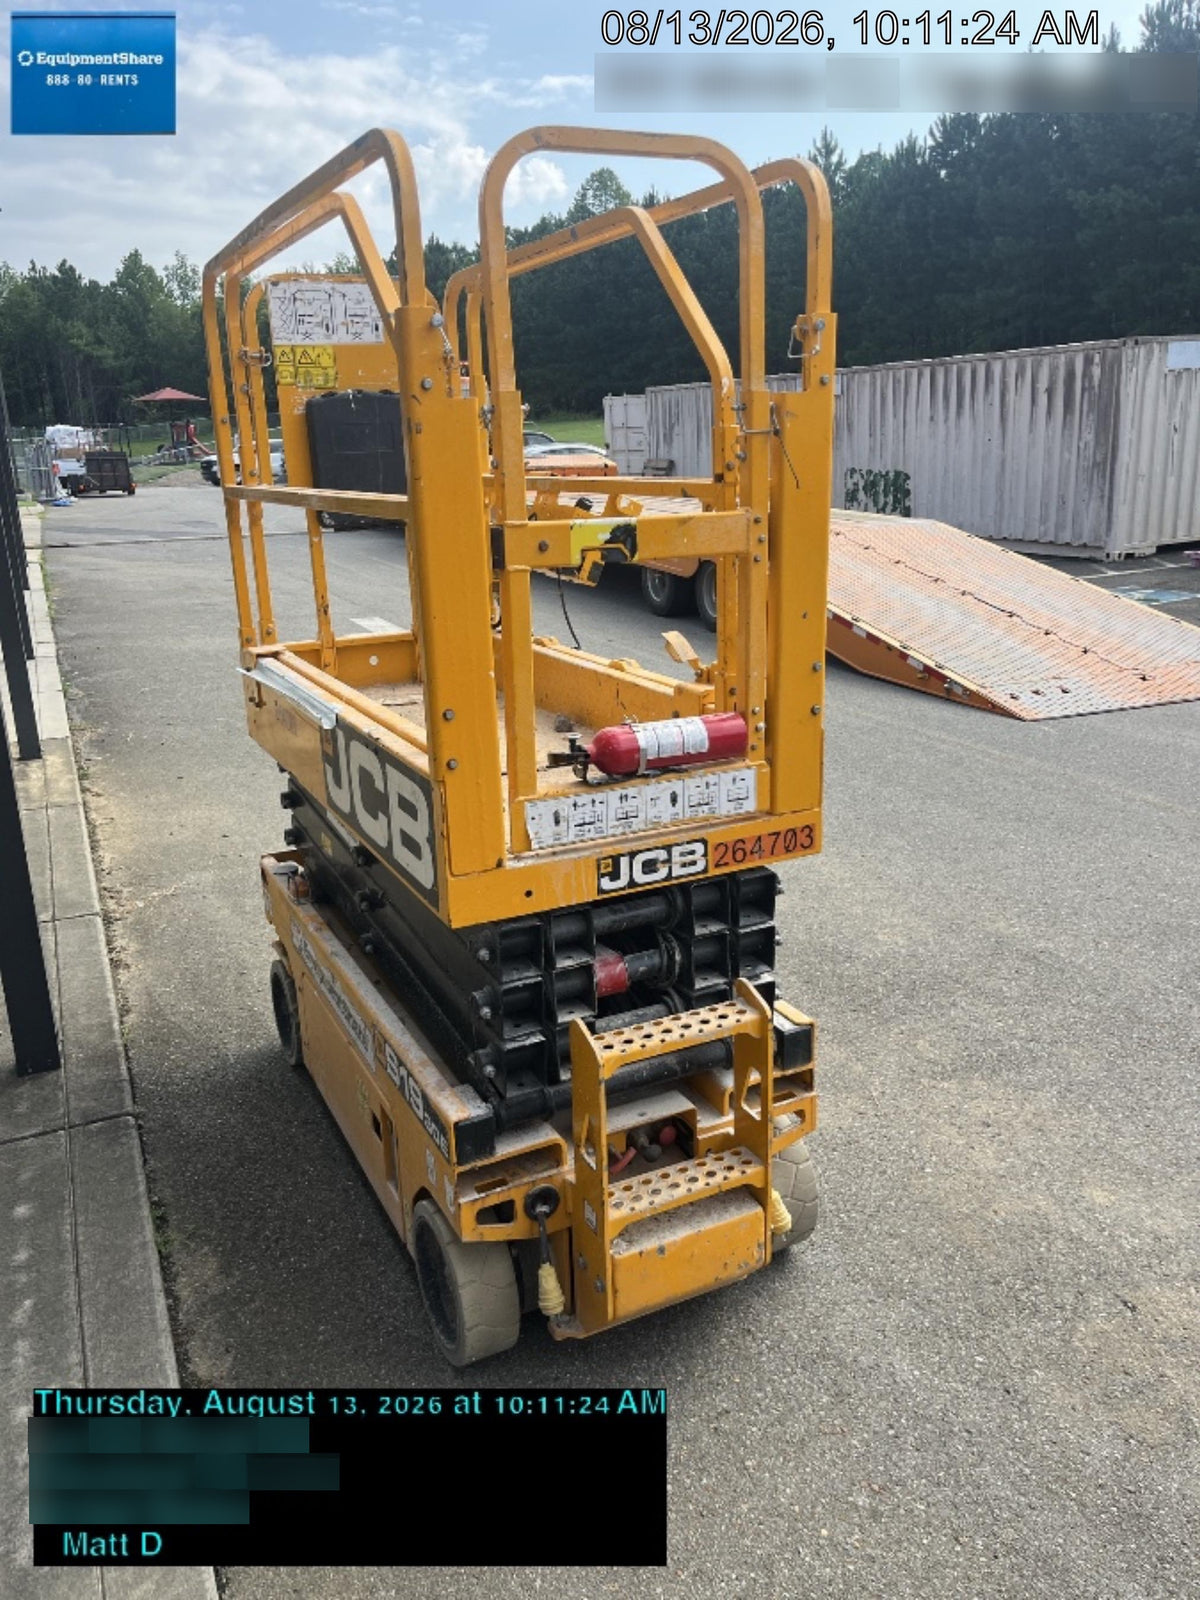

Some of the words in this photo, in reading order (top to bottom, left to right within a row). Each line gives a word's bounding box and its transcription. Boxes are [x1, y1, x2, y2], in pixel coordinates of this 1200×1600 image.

[325, 728, 435, 890] JCB
[600, 841, 707, 891] JCB
[713, 824, 815, 869] 264703
